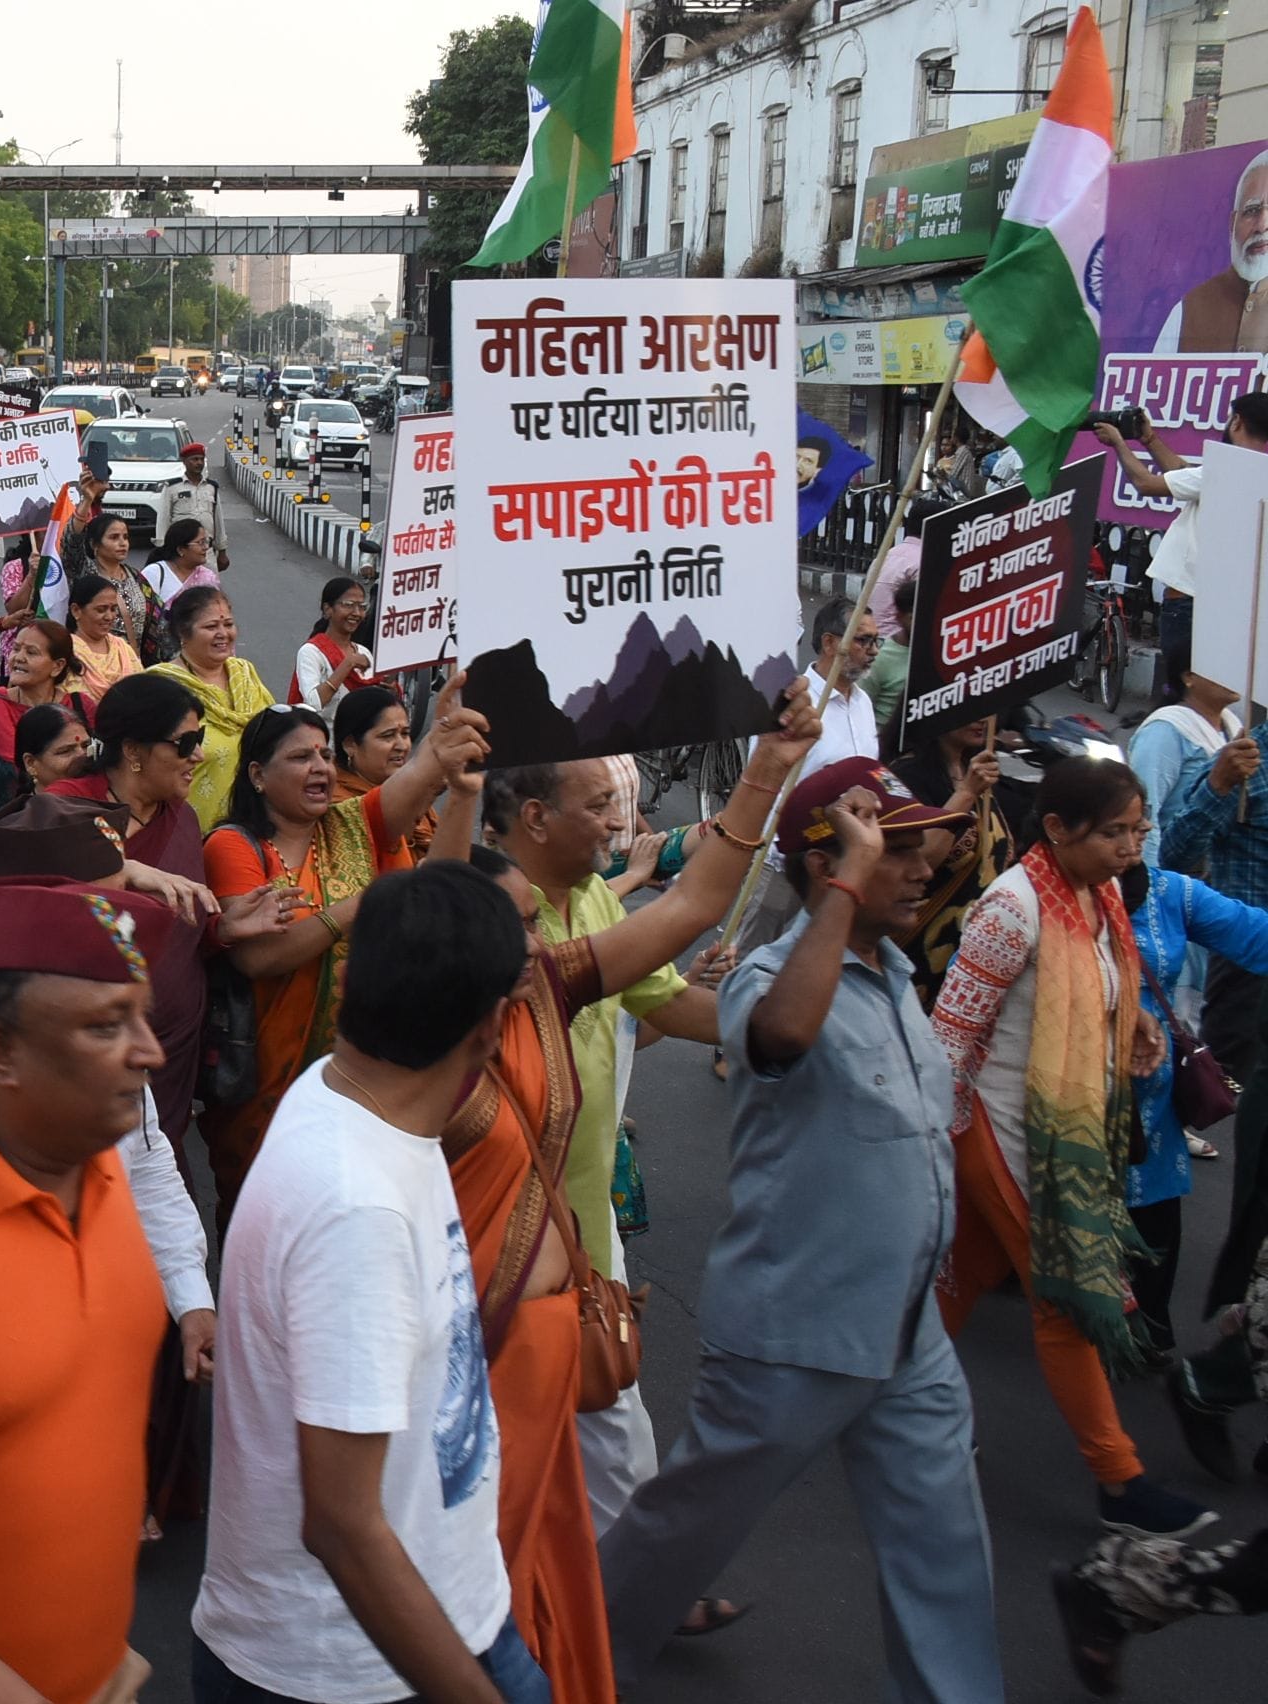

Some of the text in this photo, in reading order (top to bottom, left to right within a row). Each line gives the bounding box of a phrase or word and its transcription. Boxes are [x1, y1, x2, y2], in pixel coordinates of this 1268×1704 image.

[476, 297, 781, 377] महिला आरक्षण
[11, 393, 31, 408] परिवार
[20, 417, 74, 439] पहचान,
[511, 382, 757, 441] पर घटिया राजनीति,
[6, 442, 39, 466] शक्ति
[487, 458, 657, 543] सपाइयों
[660, 455, 711, 529] की
[718, 451, 776, 525] रही
[951, 488, 1076, 558] सैनिक परिवार
[393, 522, 436, 557] पर्वतीय
[958, 536, 1054, 593] का अनादर,
[393, 564, 442, 597] समाज
[562, 544, 725, 624] पुरानी निति
[382, 597, 448, 639] मैदान में
[941, 572, 1063, 666] सपा का
[906, 631, 1078, 724] असली चेहरा उजागर।
